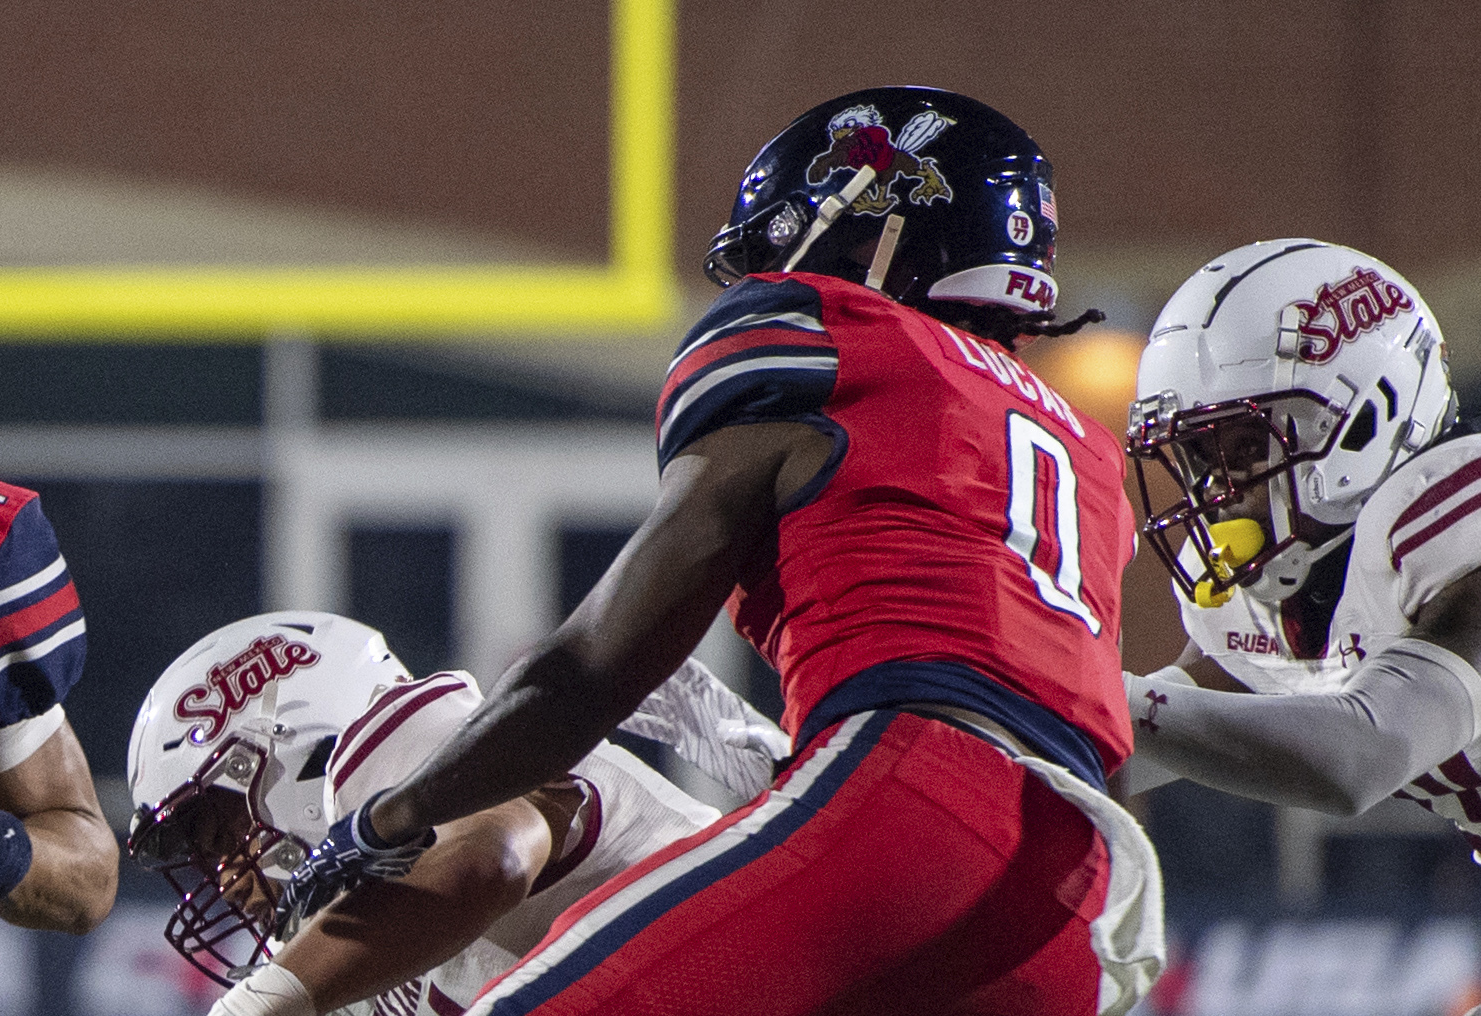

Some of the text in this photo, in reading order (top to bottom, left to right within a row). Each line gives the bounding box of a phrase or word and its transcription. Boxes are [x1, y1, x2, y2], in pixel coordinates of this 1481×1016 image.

[1012, 214, 1030, 229] TB
[1013, 228, 1029, 241] 77
[1005, 270, 1056, 309] FLA
[1295, 265, 1416, 367] State
[939, 322, 1086, 439] LUCAS
[1002, 407, 1102, 640] 0
[173, 632, 322, 747] State
